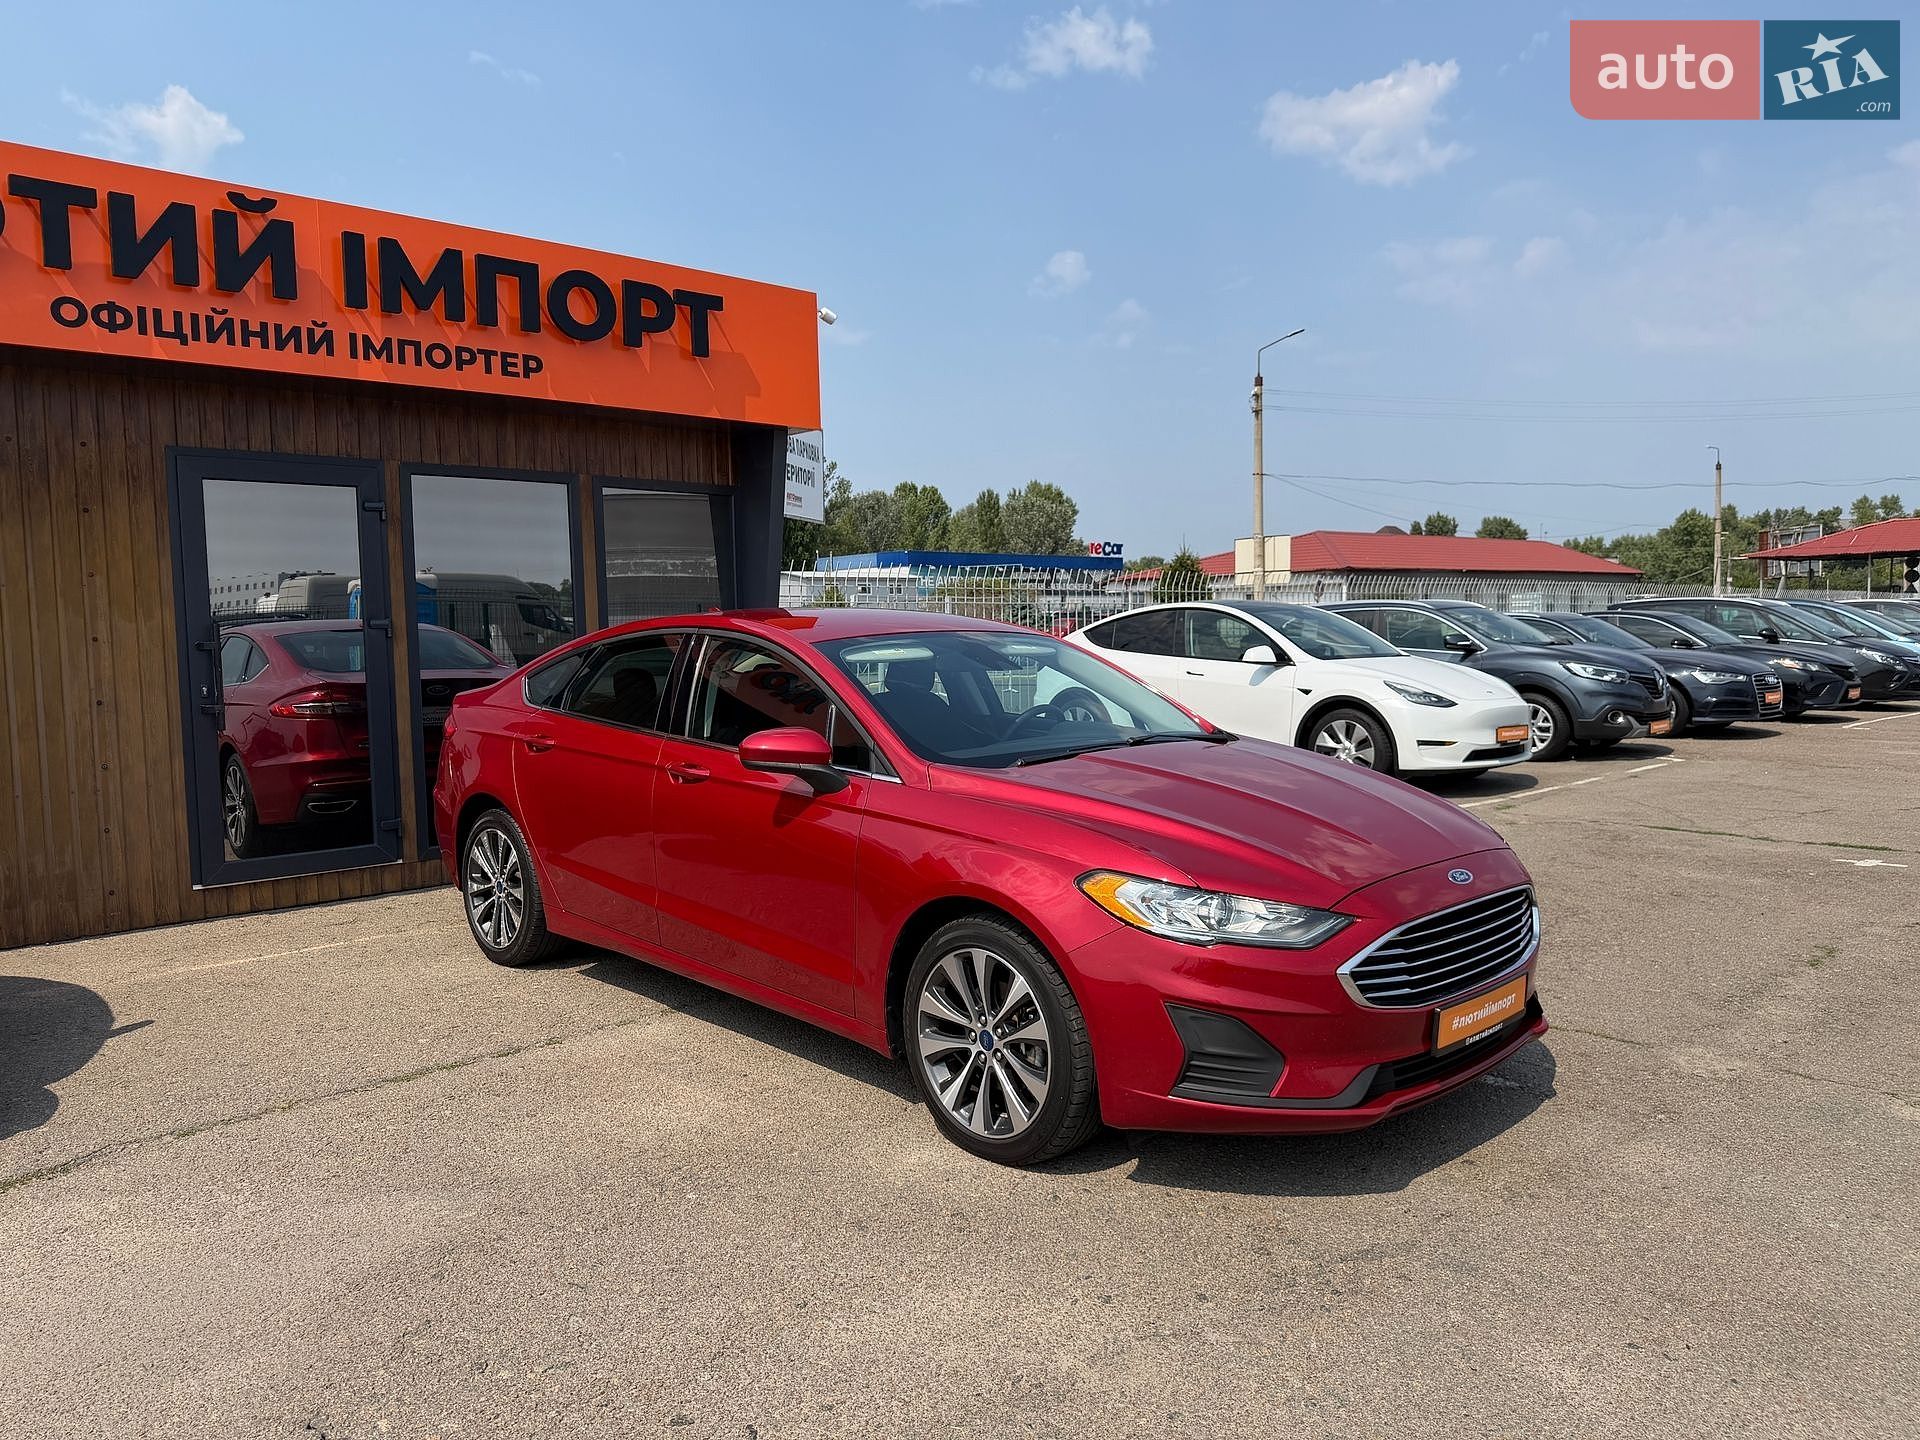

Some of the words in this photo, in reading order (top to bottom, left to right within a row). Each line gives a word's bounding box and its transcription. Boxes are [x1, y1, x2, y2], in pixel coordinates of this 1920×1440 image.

[0, 173, 299, 301] ТИЙ
[341, 230, 724, 359] ІМПОРТ
[49, 295, 335, 358] ОФІЦІЙНИЙ
[348, 332, 544, 380] ІМПОРТЕР
[786, 462, 816, 489] ЕРИТОРІЇ
[1451, 993, 1516, 1031] #лютийімпорт
